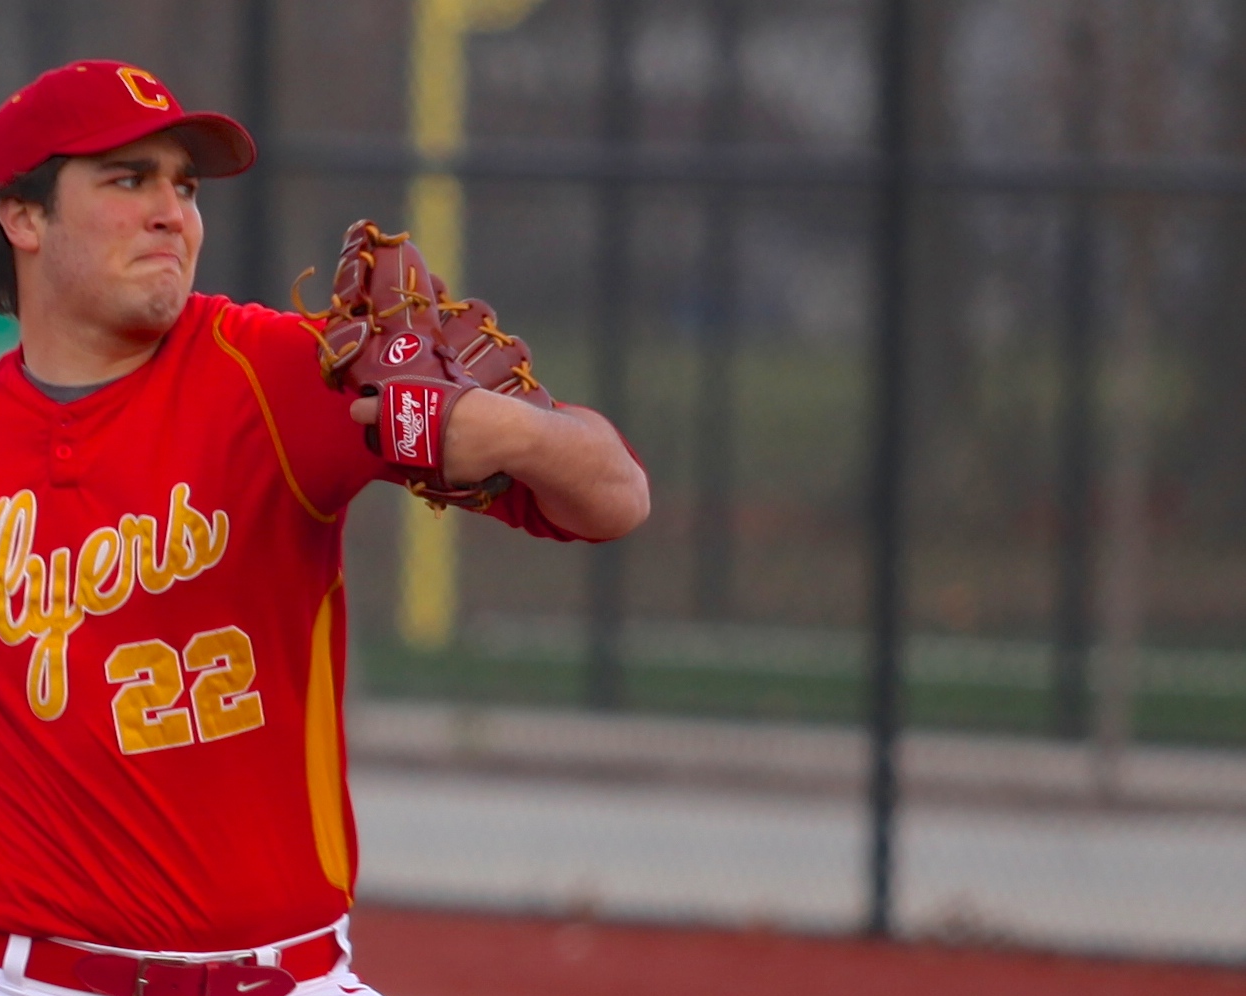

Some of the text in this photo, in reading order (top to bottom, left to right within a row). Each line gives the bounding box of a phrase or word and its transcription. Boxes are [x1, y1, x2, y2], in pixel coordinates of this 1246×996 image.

[116, 66, 170, 111] C
[388, 337, 419, 364] R
[395, 390, 421, 458] Rawlings
[104, 625, 265, 755] 22
